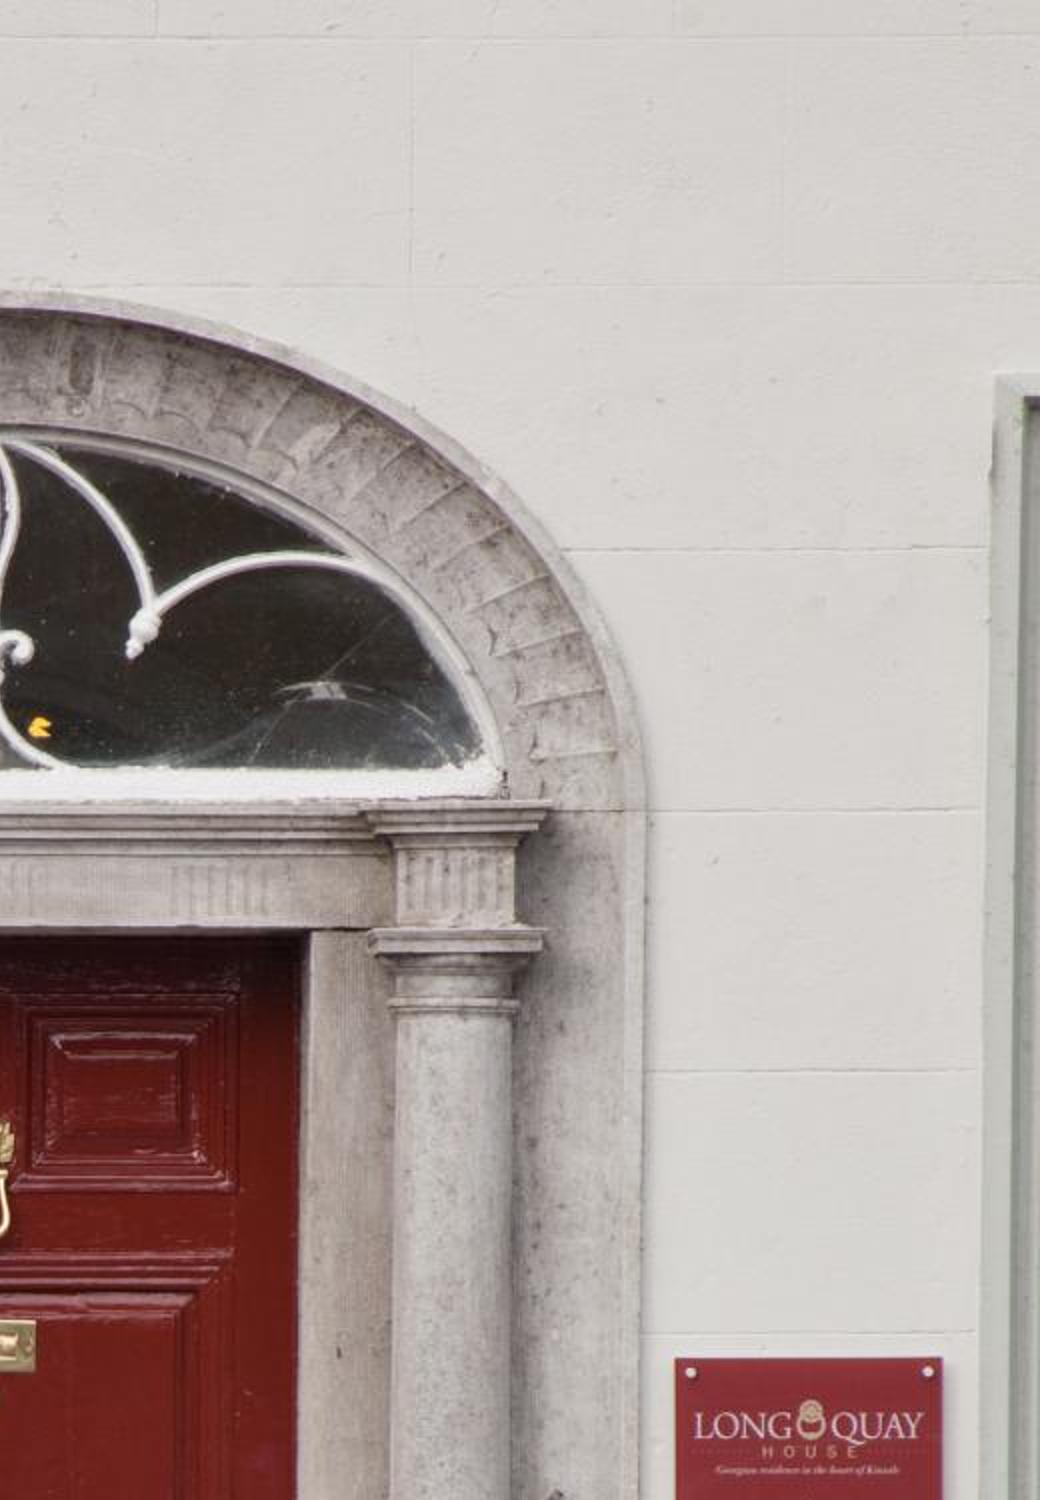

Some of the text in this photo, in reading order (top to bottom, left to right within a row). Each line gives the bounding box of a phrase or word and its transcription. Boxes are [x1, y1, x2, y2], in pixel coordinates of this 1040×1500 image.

[694, 1411, 925, 1446] LONG QUAY
[762, 1446, 859, 1459] HOUSE
